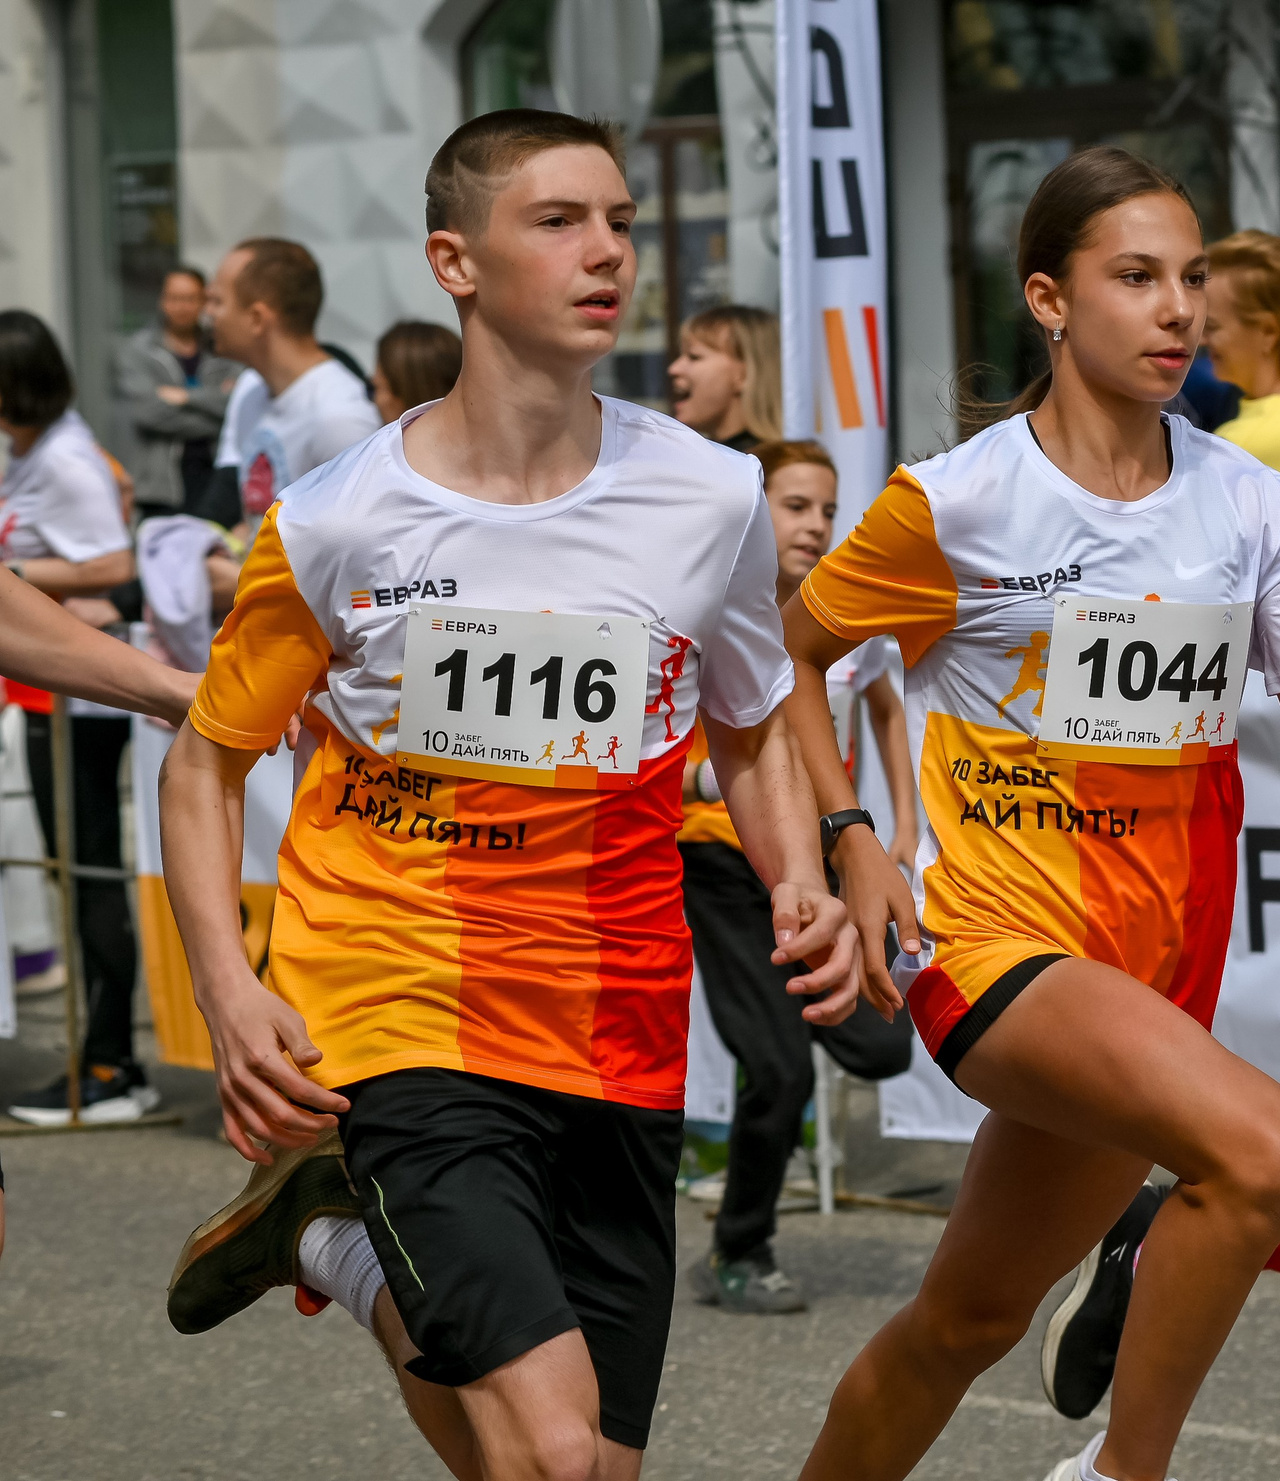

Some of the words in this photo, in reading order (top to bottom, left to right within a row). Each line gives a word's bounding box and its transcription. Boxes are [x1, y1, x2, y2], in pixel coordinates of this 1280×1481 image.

[1000, 564, 1082, 593] ЕВРАЗ
[374, 578, 458, 608] ЕВРАЗ
[445, 620, 498, 635] ЕВРАЗ
[1088, 610, 1136, 624] ЕВРАЗ
[1077, 638, 1230, 703] 1044
[434, 648, 618, 723] 1116
[1063, 717, 1089, 740] 10
[1094, 718, 1120, 728] ЗАБЕГ
[422, 729, 449, 753] 10
[454, 732, 482, 743] ЗАБЕГ
[1090, 728, 1123, 742] ДАЙ
[1126, 732, 1161, 744] ПЯТЬ
[451, 742, 485, 758] ДАЙ
[490, 747, 530, 763] ПЯТЬ
[951, 757, 972, 781] 10
[976, 761, 1059, 788] ЗАБЕГ
[408, 812, 526, 851] ПЯТЬ!
[1036, 801, 1139, 838] ПЯТЬ!
